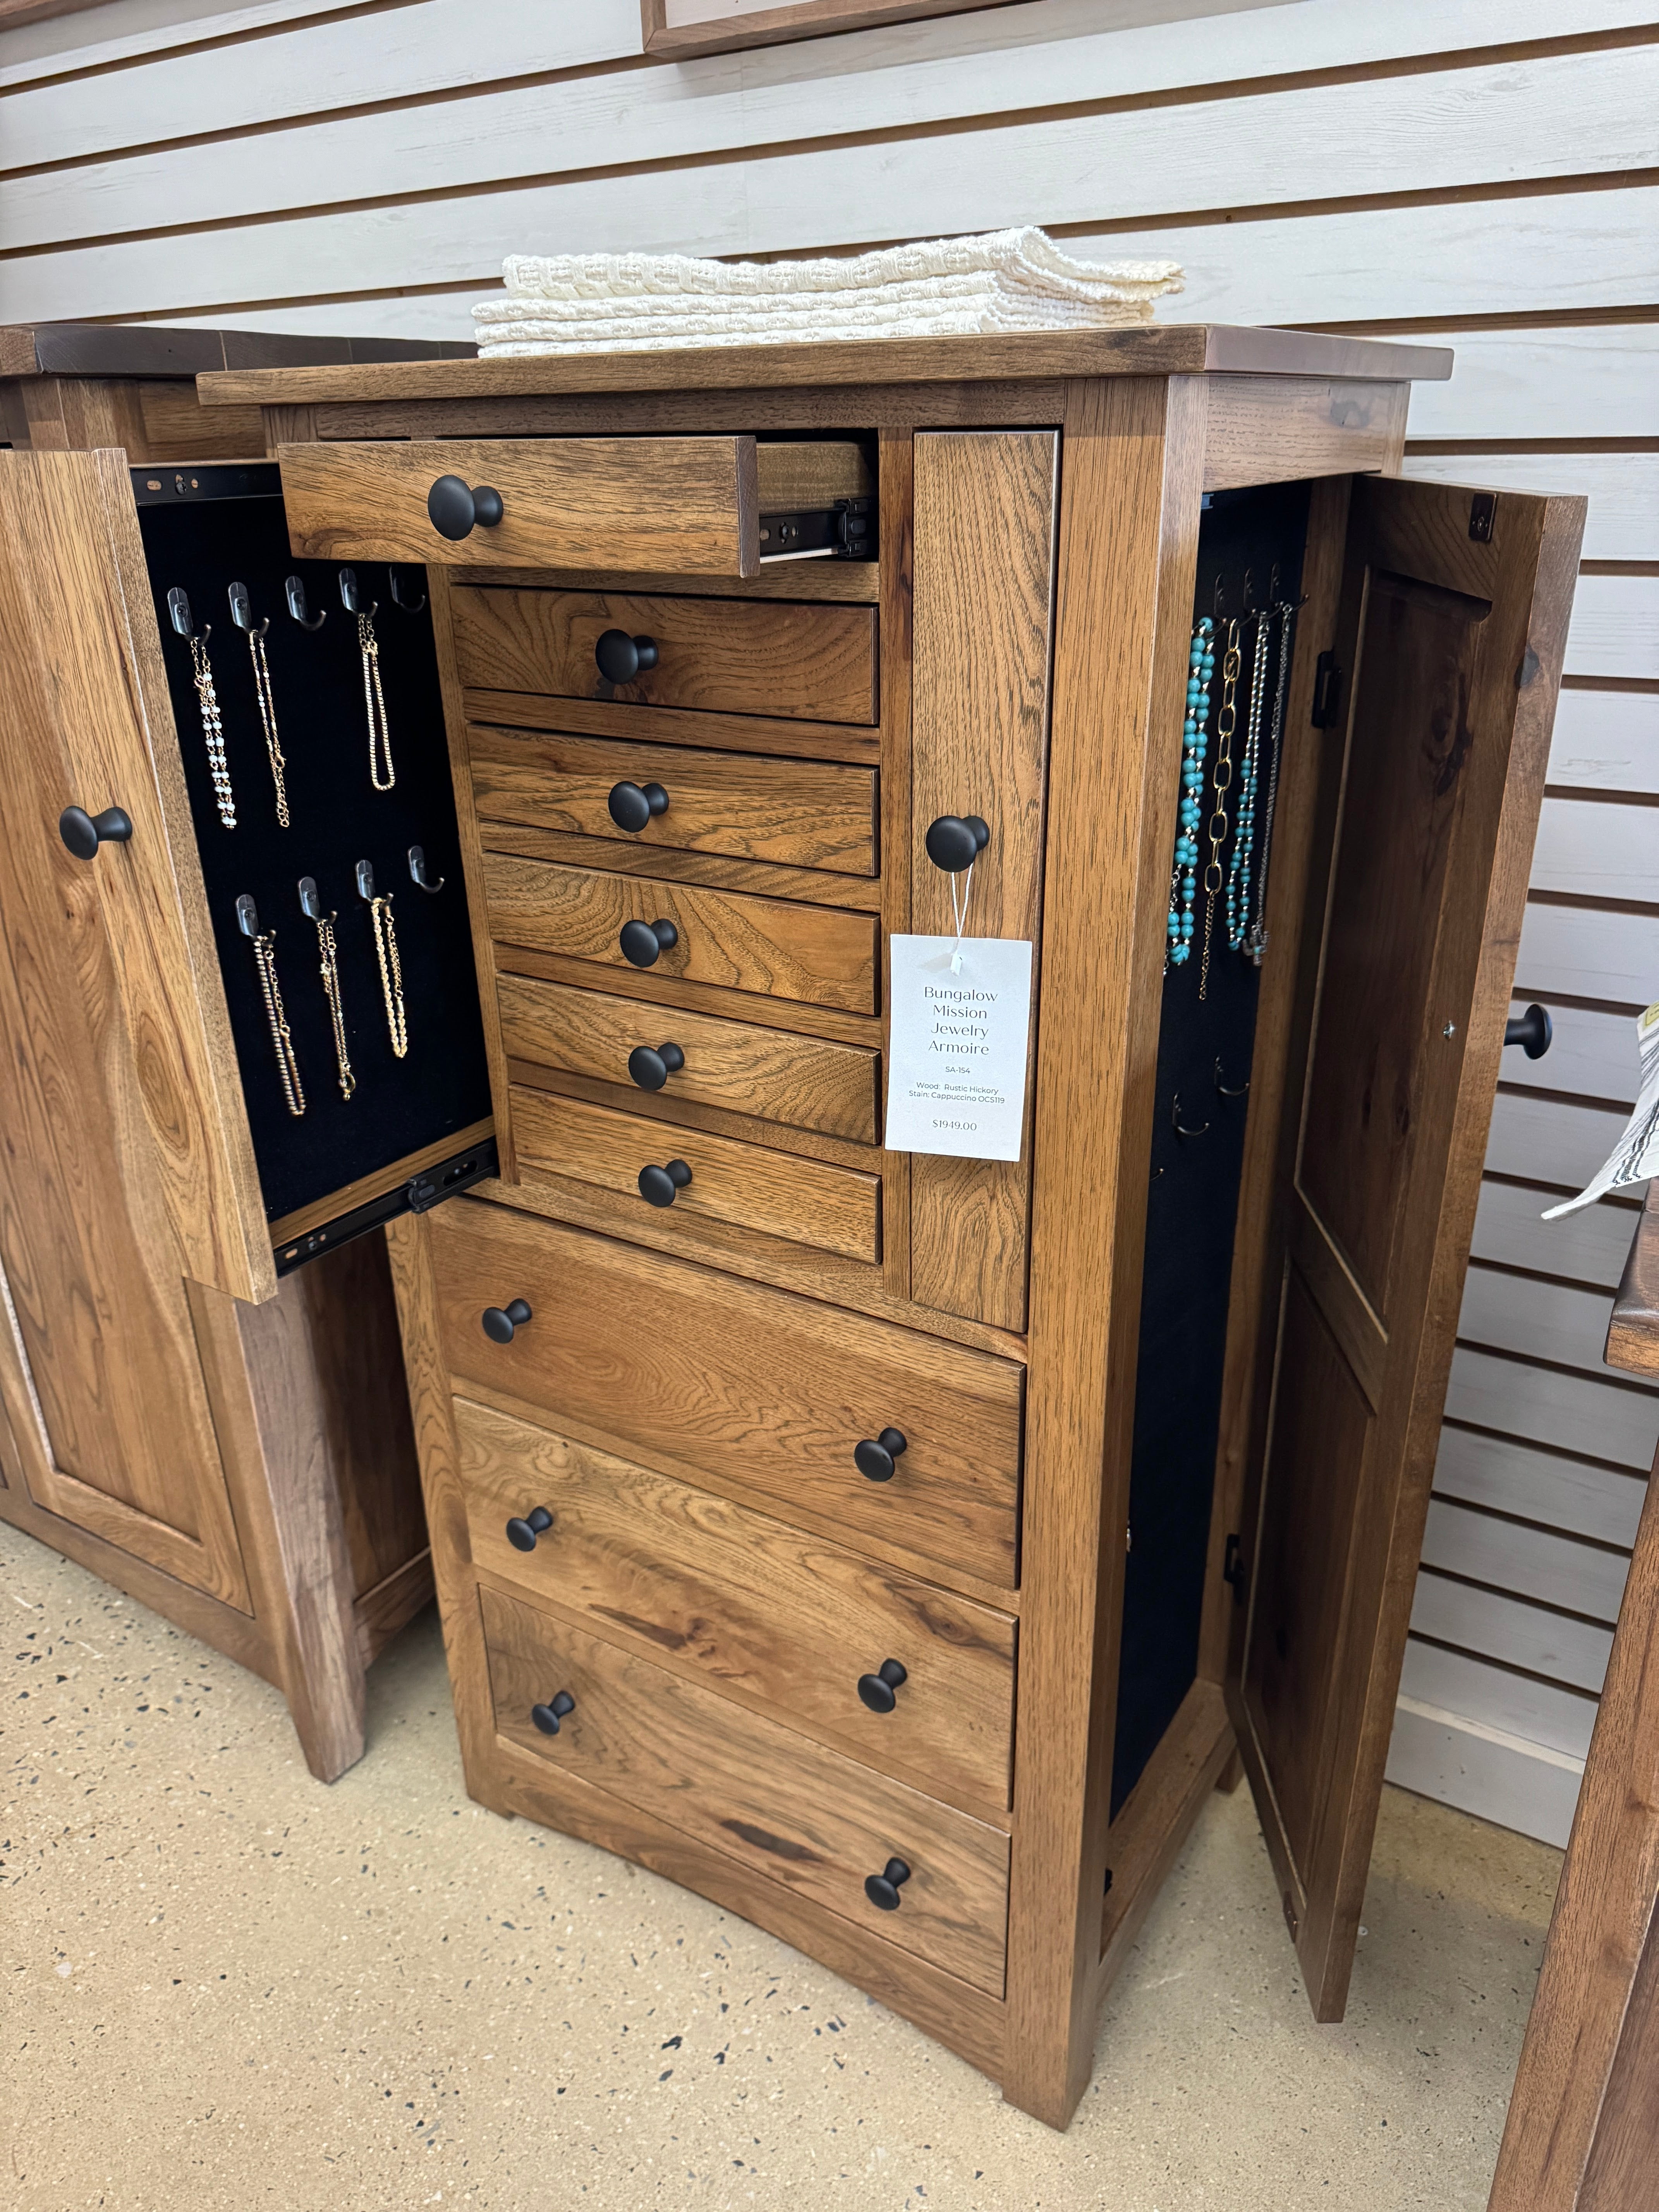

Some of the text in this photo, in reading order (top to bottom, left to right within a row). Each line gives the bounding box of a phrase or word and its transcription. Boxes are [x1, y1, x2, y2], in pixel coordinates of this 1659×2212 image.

[925, 987, 998, 1002] Bungalow
[933, 1005, 987, 1019] Mission
[931, 1023, 989, 1039] Jewelry
[929, 1041, 989, 1055] Armoire
[944, 1084, 968, 1092] Rustic
[970, 1086, 999, 1095] Hickory
[931, 1092, 976, 1102] Cappuccino
[933, 1120, 977, 1131] $1949.00
